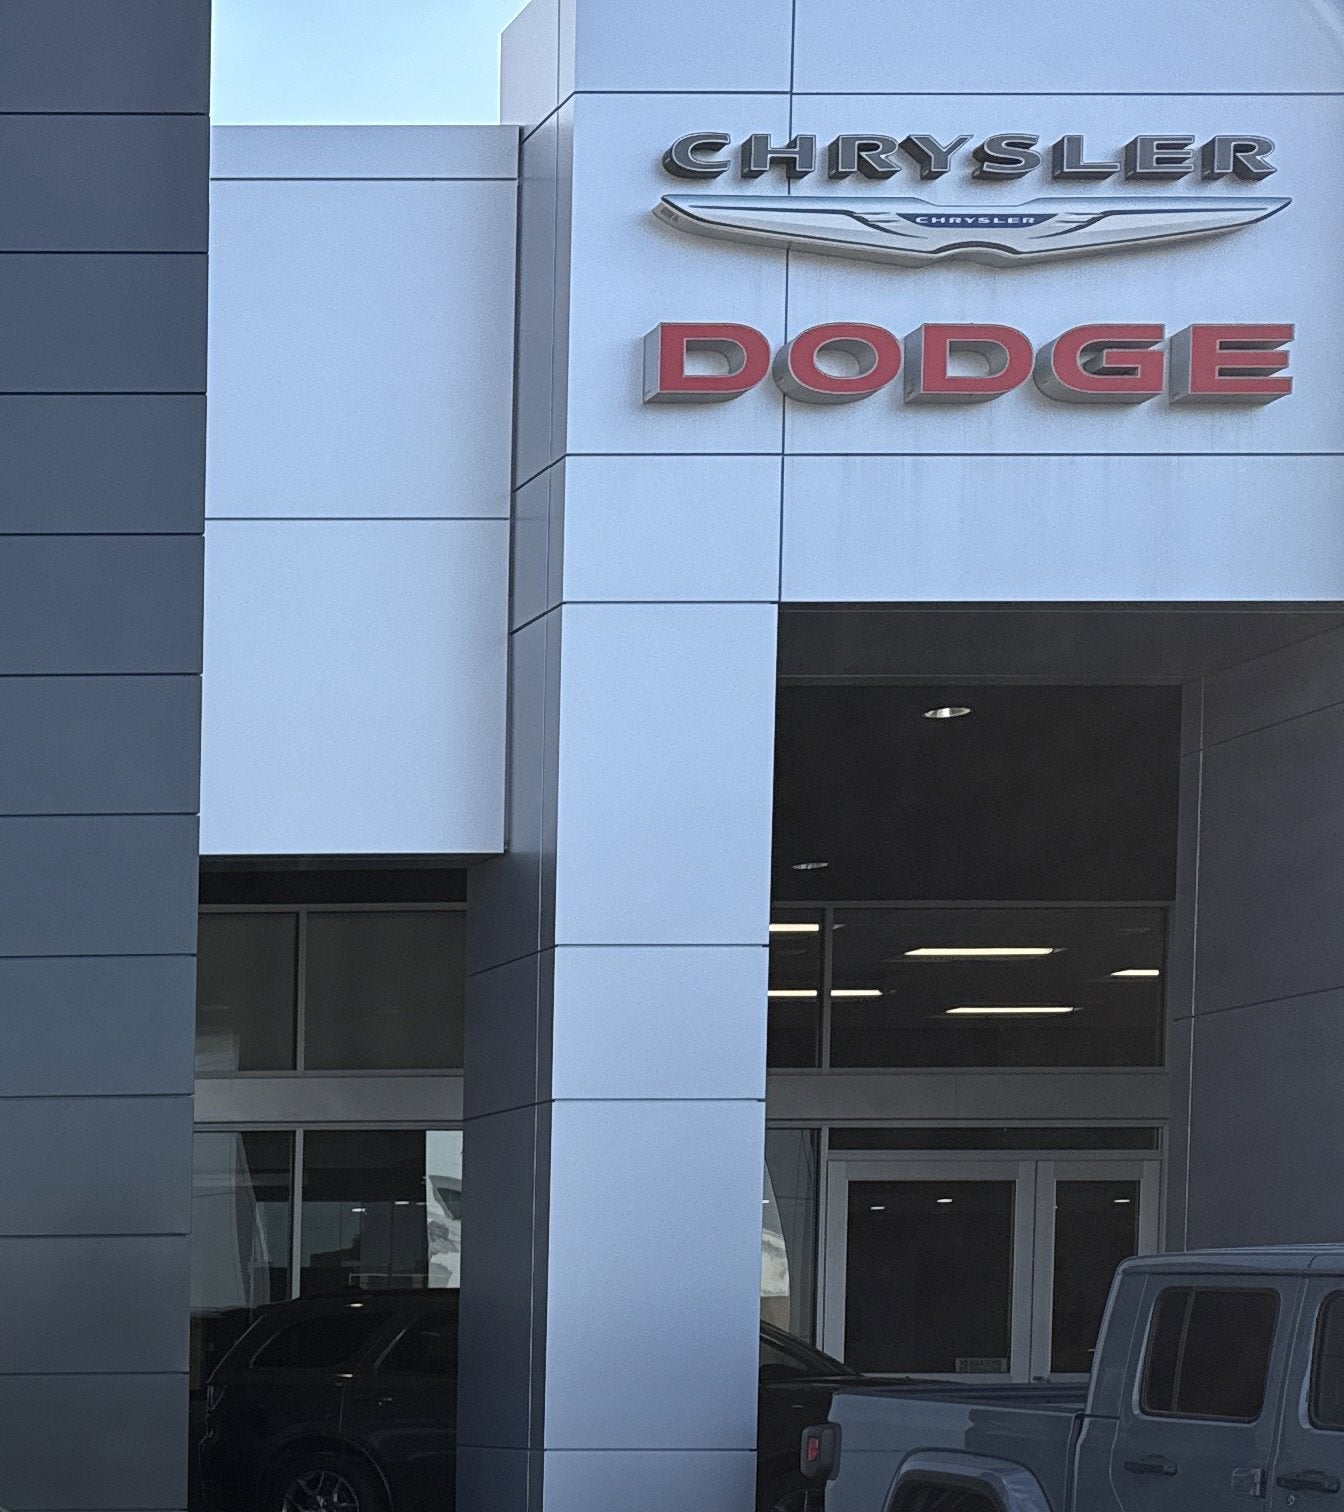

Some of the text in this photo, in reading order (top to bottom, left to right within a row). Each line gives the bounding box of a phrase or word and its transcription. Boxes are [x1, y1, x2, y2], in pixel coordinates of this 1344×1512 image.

[663, 131, 1279, 180] CHRYSLER
[913, 214, 1037, 226] CHRYSLER
[644, 322, 1296, 404] DODGE
